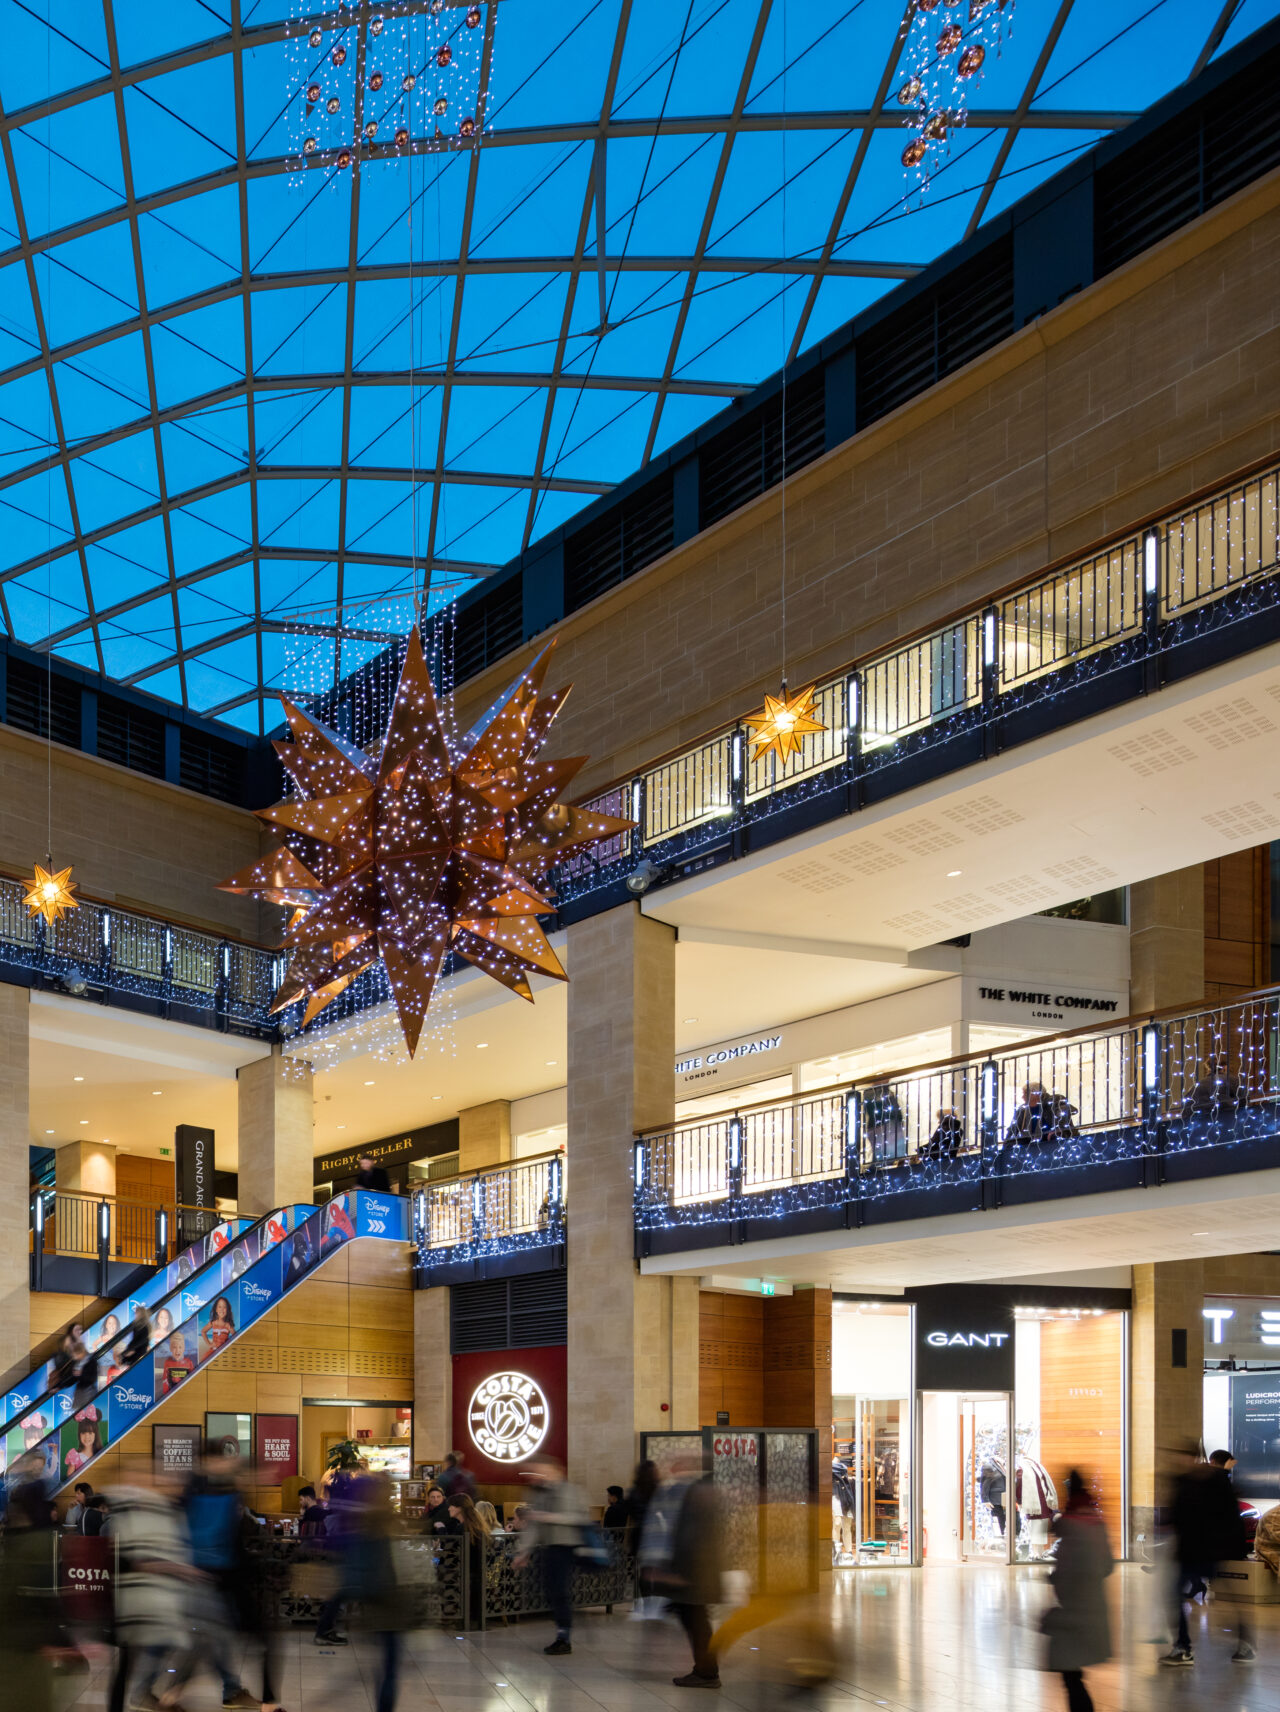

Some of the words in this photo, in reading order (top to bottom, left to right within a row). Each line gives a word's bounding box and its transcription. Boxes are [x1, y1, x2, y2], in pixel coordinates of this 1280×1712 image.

[979, 987, 1005, 1001] THE
[1008, 990, 1051, 1006] WHITE
[1055, 995, 1119, 1012] COMPANY
[1032, 1011, 1063, 1019] LONDON
[706, 1035, 782, 1065] COMPANY
[684, 1068, 718, 1082] LONDON
[195, 1140, 204, 1184] GRAND
[321, 1154, 356, 1171] RIGBY
[927, 1331, 1009, 1347] GANT
[477, 1375, 533, 1406] COSTA
[1245, 1391, 1280, 1399] LUDICRO
[264, 1443, 290, 1451] HEART
[475, 1423, 543, 1459] COFFEE
[713, 1438, 757, 1458] COSTA
[163, 1448, 193, 1456] COFFEE
[163, 1455, 193, 1463] BEANS
[68, 1567, 110, 1581] COSTA
[75, 1583, 88, 1591] EST.
